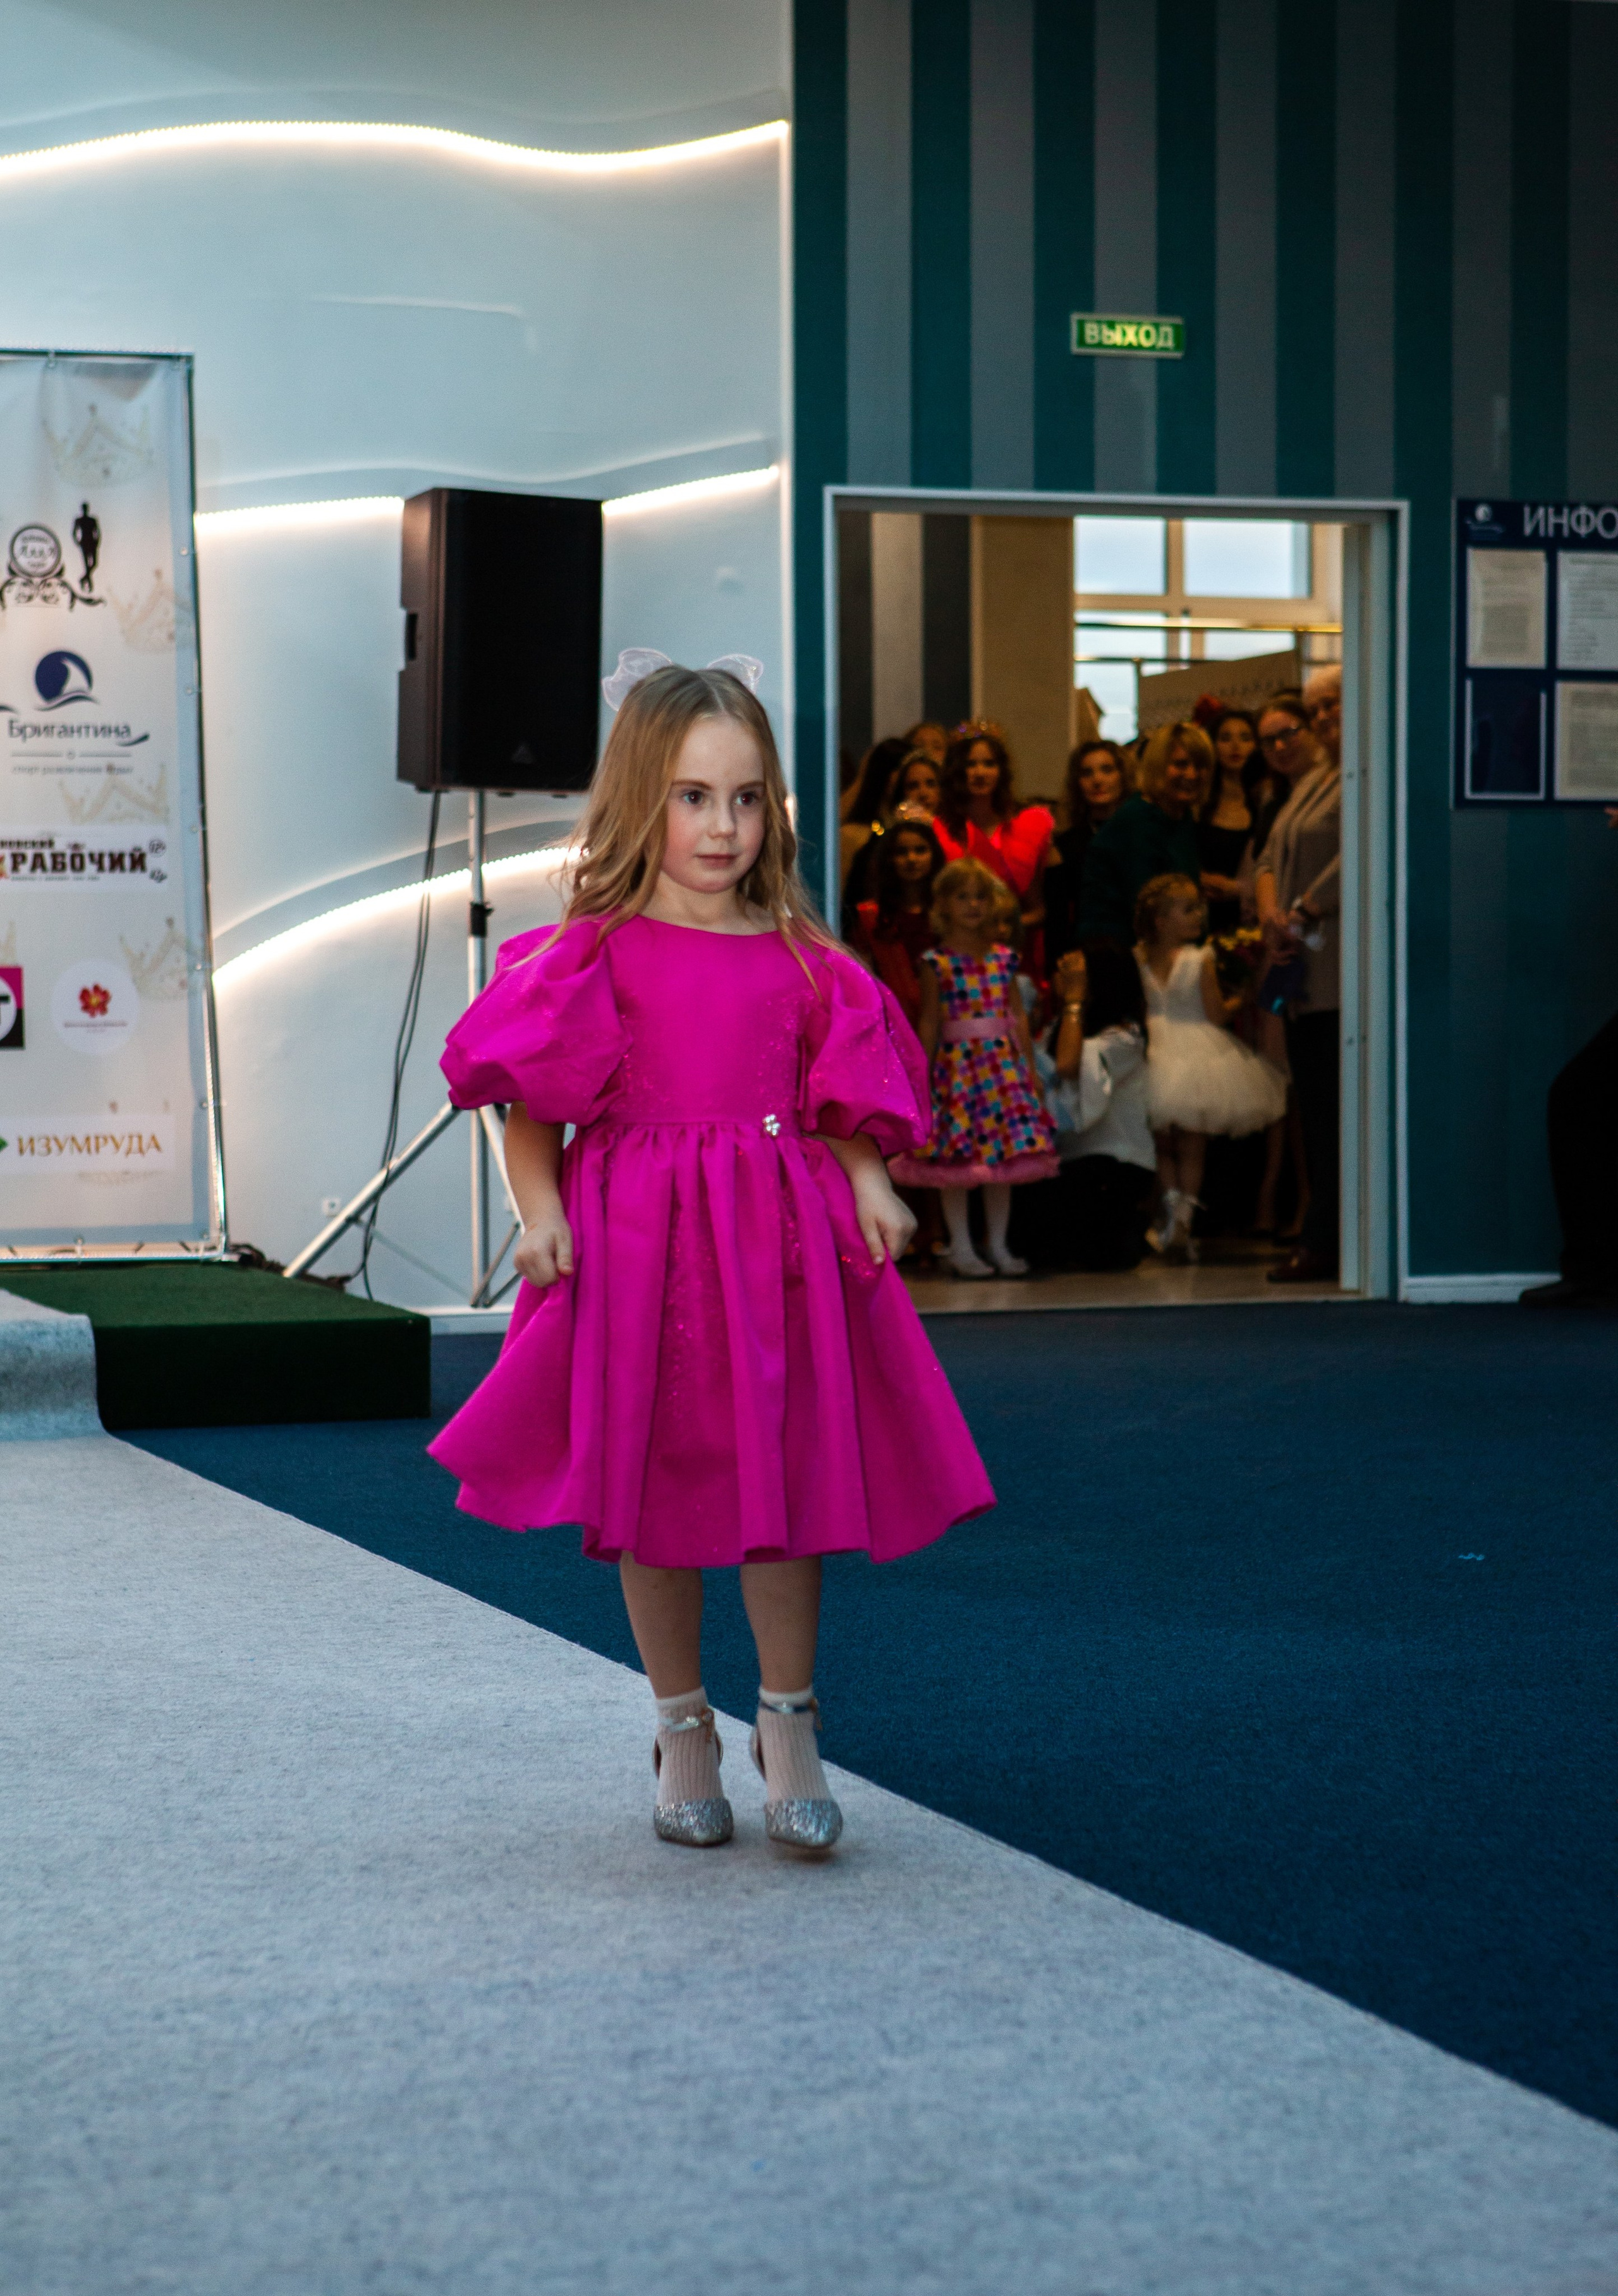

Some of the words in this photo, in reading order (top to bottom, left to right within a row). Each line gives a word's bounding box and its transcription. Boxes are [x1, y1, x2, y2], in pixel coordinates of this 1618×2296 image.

[1085, 322, 1175, 348] ВЫХОД
[1523, 505, 1618, 539] ИНФО
[8, 719, 131, 742] Бригантина
[11, 846, 147, 873] РАБОЧИЙ
[18, 1133, 162, 1158] ИЗУМРУДА
